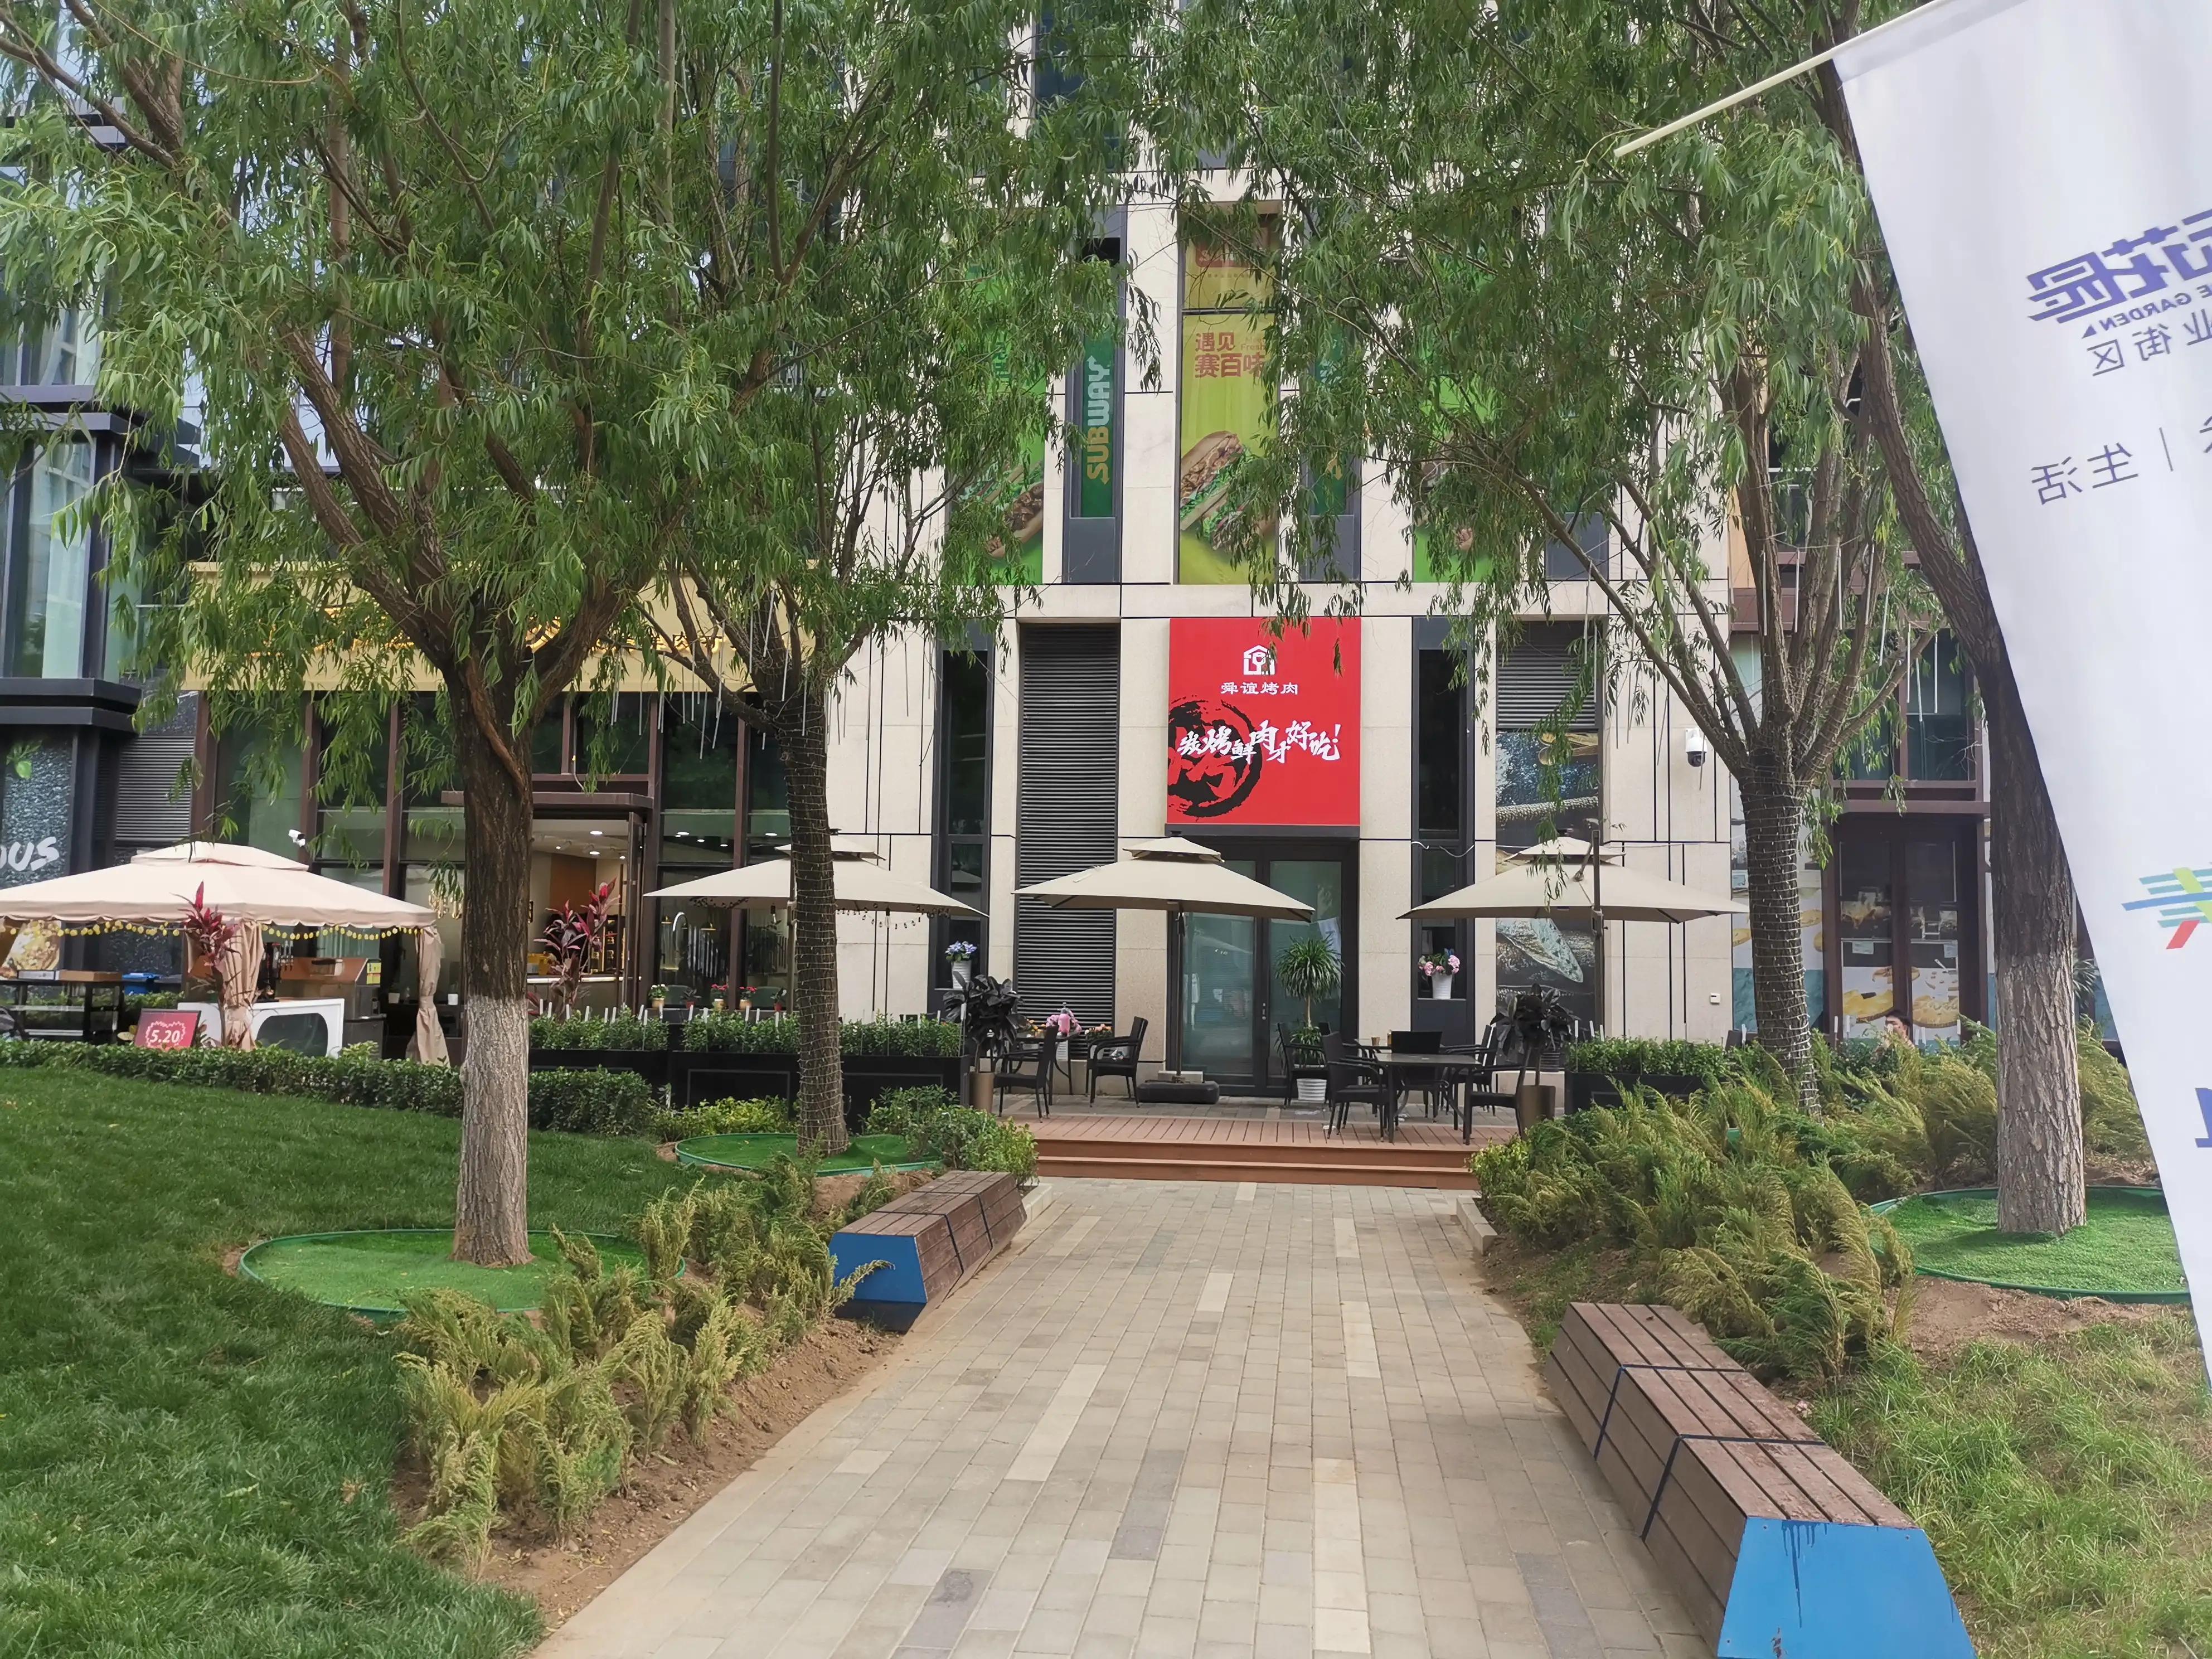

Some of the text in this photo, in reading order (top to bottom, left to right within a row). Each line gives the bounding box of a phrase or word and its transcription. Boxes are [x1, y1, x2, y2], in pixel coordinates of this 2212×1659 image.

[1195, 332, 1235, 352] 遇见
[1087, 355, 1110, 484] SUBWAY
[1220, 682, 1298, 695] 舜谊烤肉
[150, 1030, 180, 1043] 5.20
